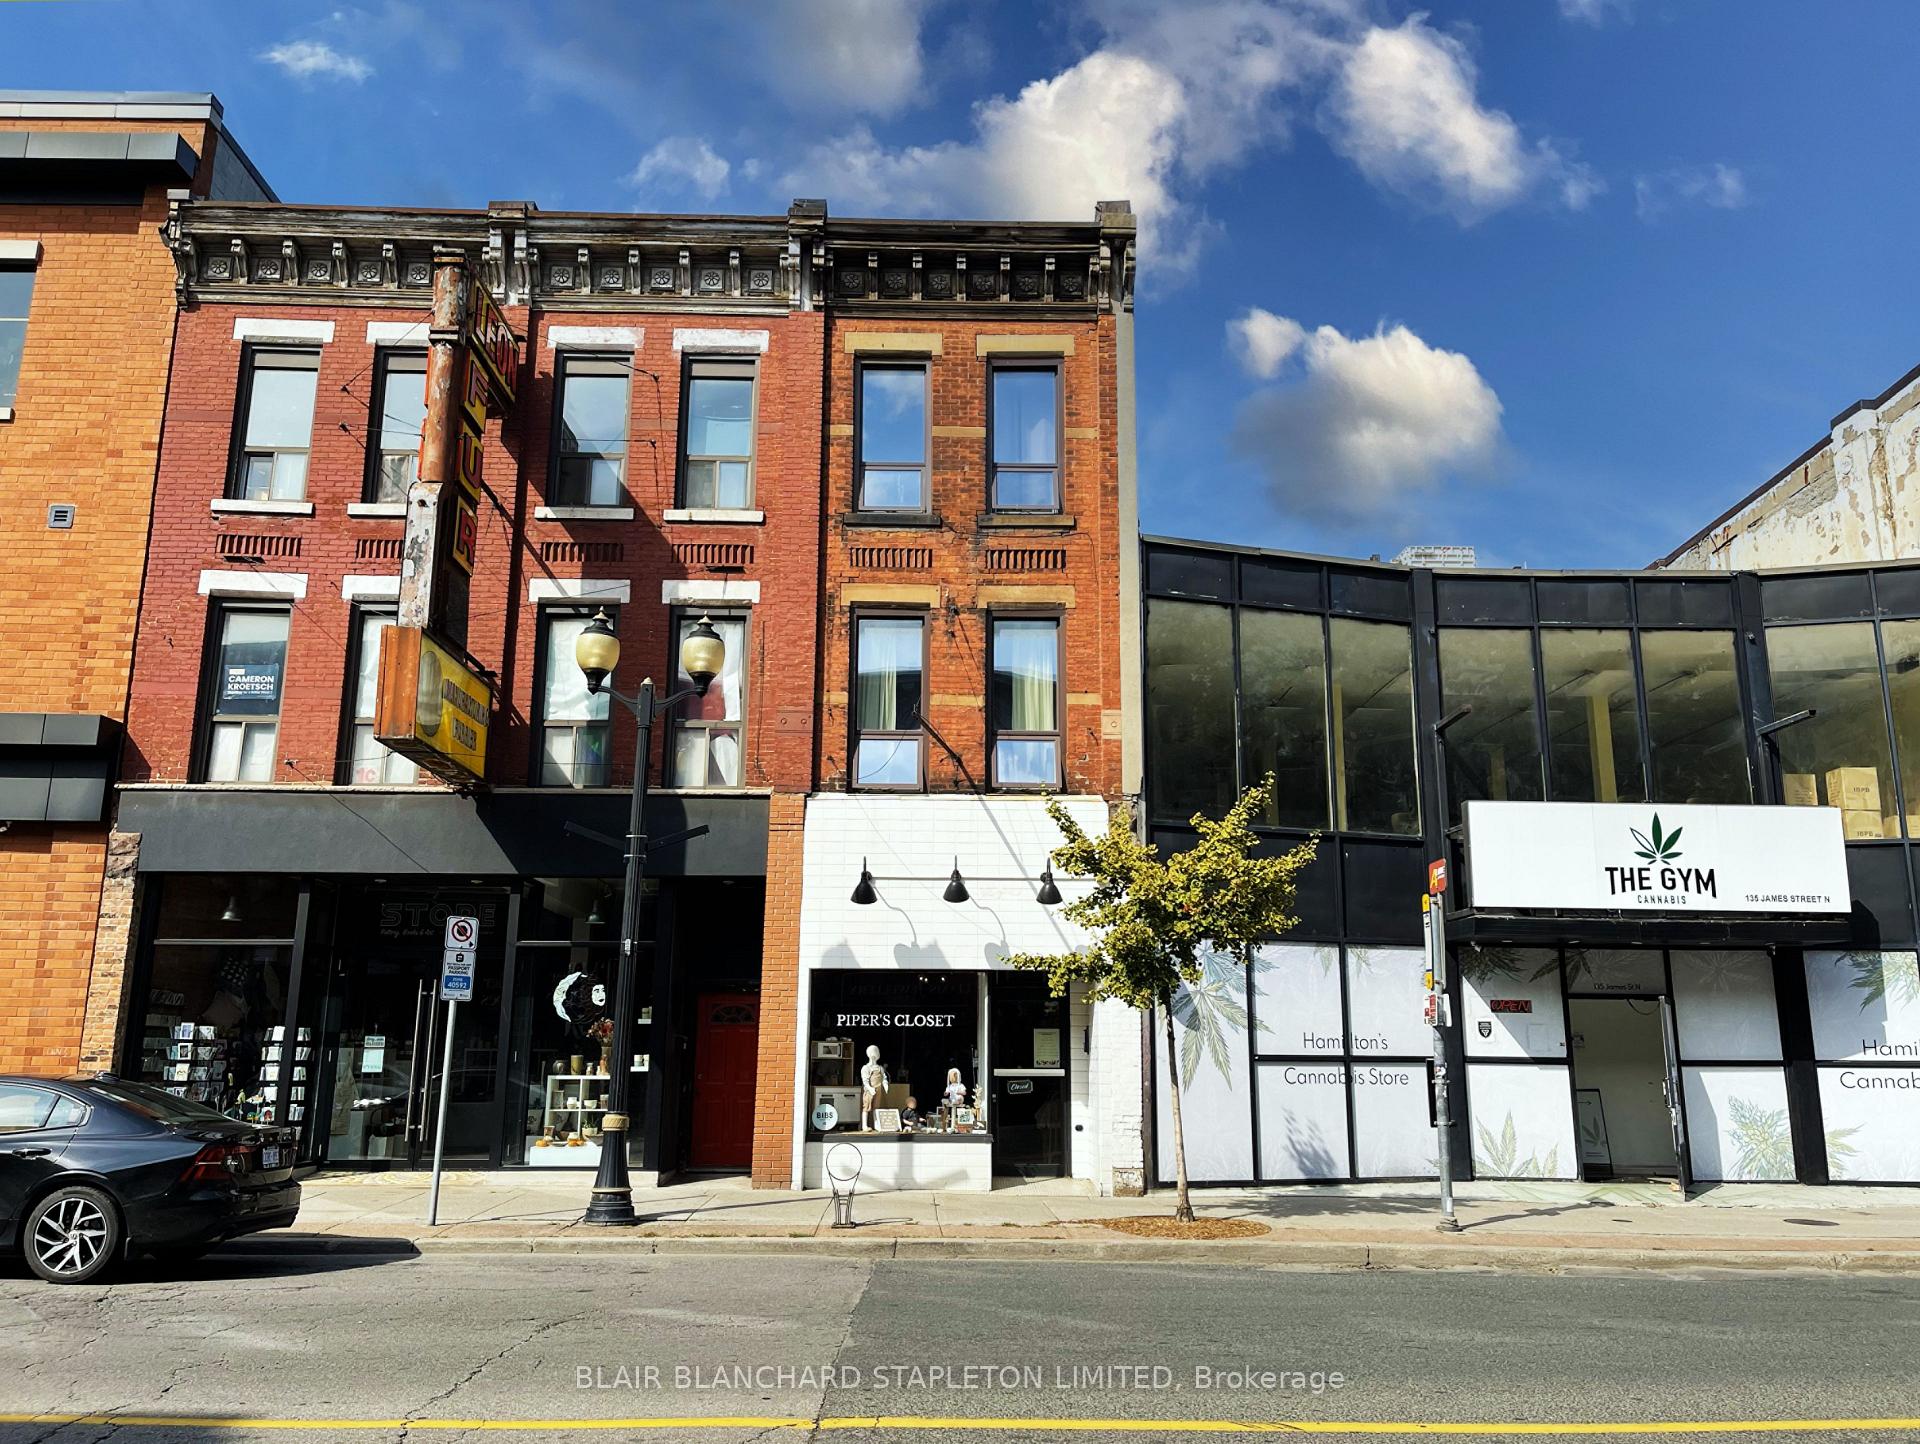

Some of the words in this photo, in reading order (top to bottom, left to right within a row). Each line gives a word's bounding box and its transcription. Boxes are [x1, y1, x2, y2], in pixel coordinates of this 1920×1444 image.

[475, 286, 518, 395] LEON
[457, 360, 489, 568] FUR
[228, 675, 275, 683] CAMERON
[1604, 867, 1651, 895] THE
[1660, 868, 1717, 899] GYM
[1637, 895, 1687, 905] CANNABIS
[1745, 895, 1759, 903] 135
[1760, 895, 1789, 903] JAMES
[1790, 895, 1821, 903] STREET
[447, 981, 467, 989] 40592
[1491, 1000, 1531, 1012] OPEN
[836, 1014, 891, 1027] PIPER'S
[894, 1014, 956, 1027] CLOSET
[1284, 1067, 1365, 1085] Cannabis
[1369, 1067, 1409, 1085] Store
[1840, 1071, 1920, 1089] Cannab
[816, 1111, 834, 1119] BIBS
